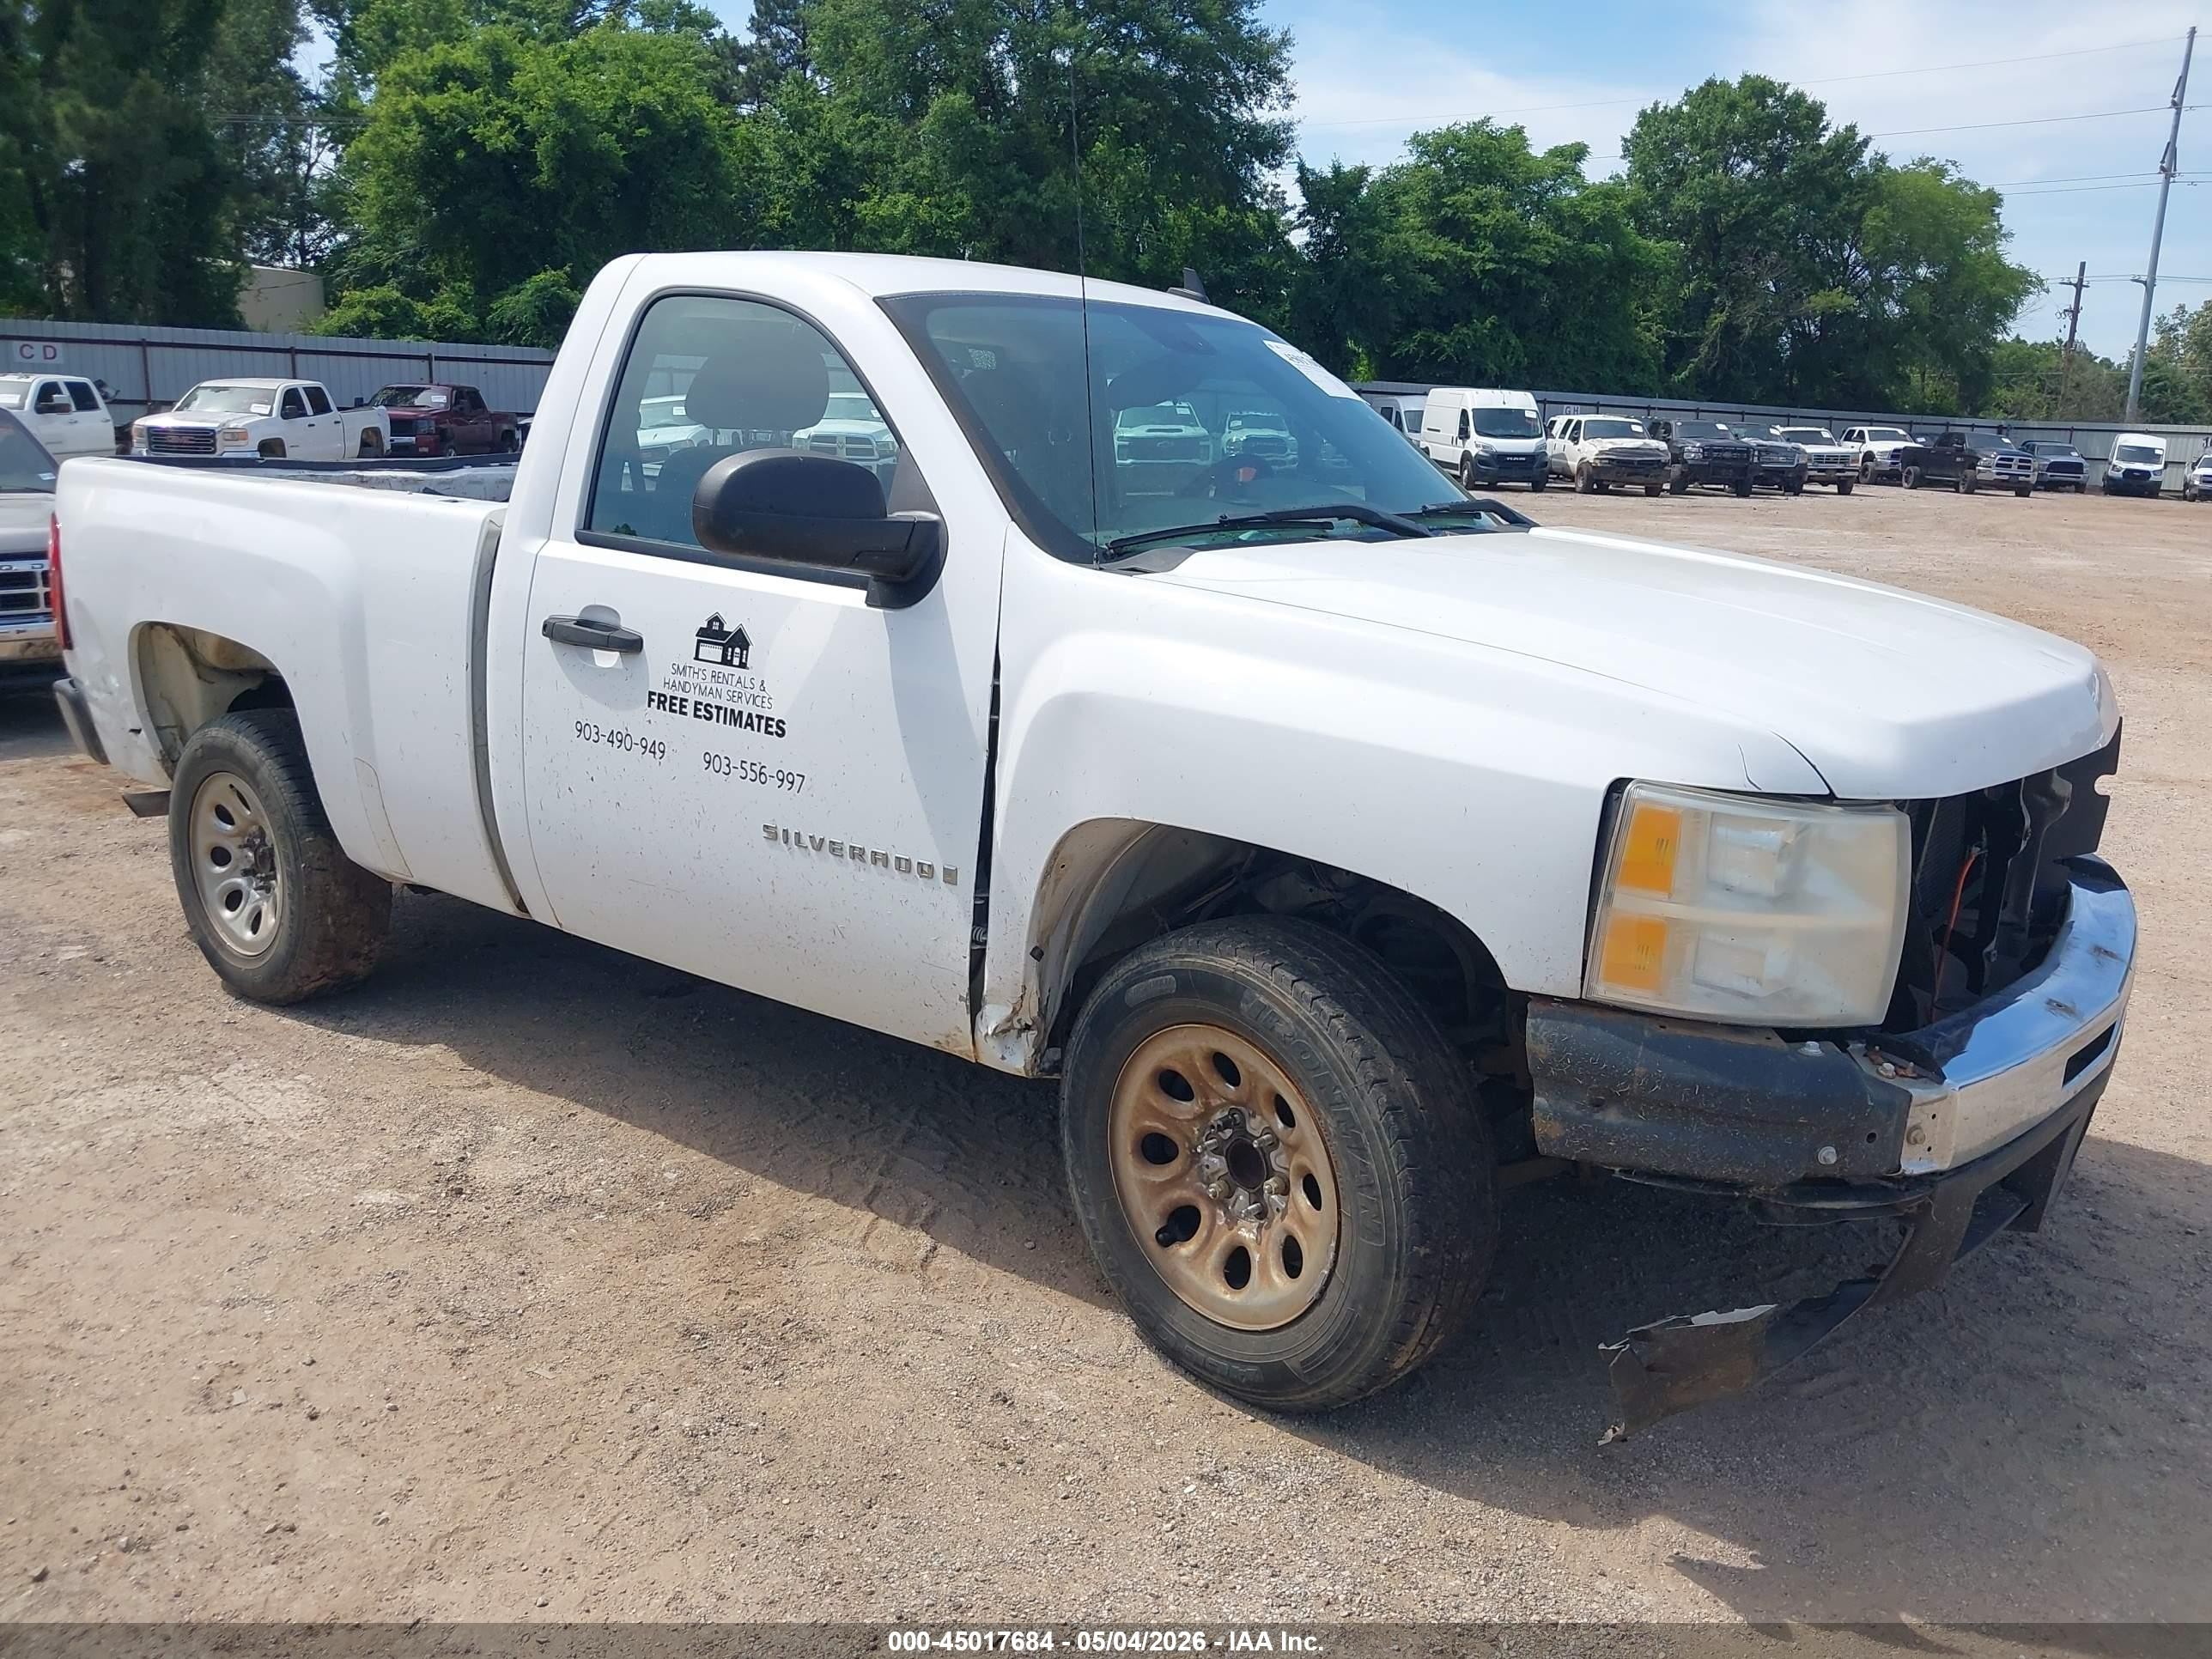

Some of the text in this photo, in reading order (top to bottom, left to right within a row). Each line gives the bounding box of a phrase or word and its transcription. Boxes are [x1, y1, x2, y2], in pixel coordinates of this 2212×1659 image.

[20, 343, 57, 360] C D
[663, 677, 773, 709] HANDYMAN SERVICES
[672, 662, 766, 692] SMITH'S RENTALS &
[647, 690, 787, 738] FREE ESTIMATES
[574, 720, 666, 760] 903-490-949
[702, 751, 805, 793] 903-556-997
[763, 823, 933, 879] SILVERADO
